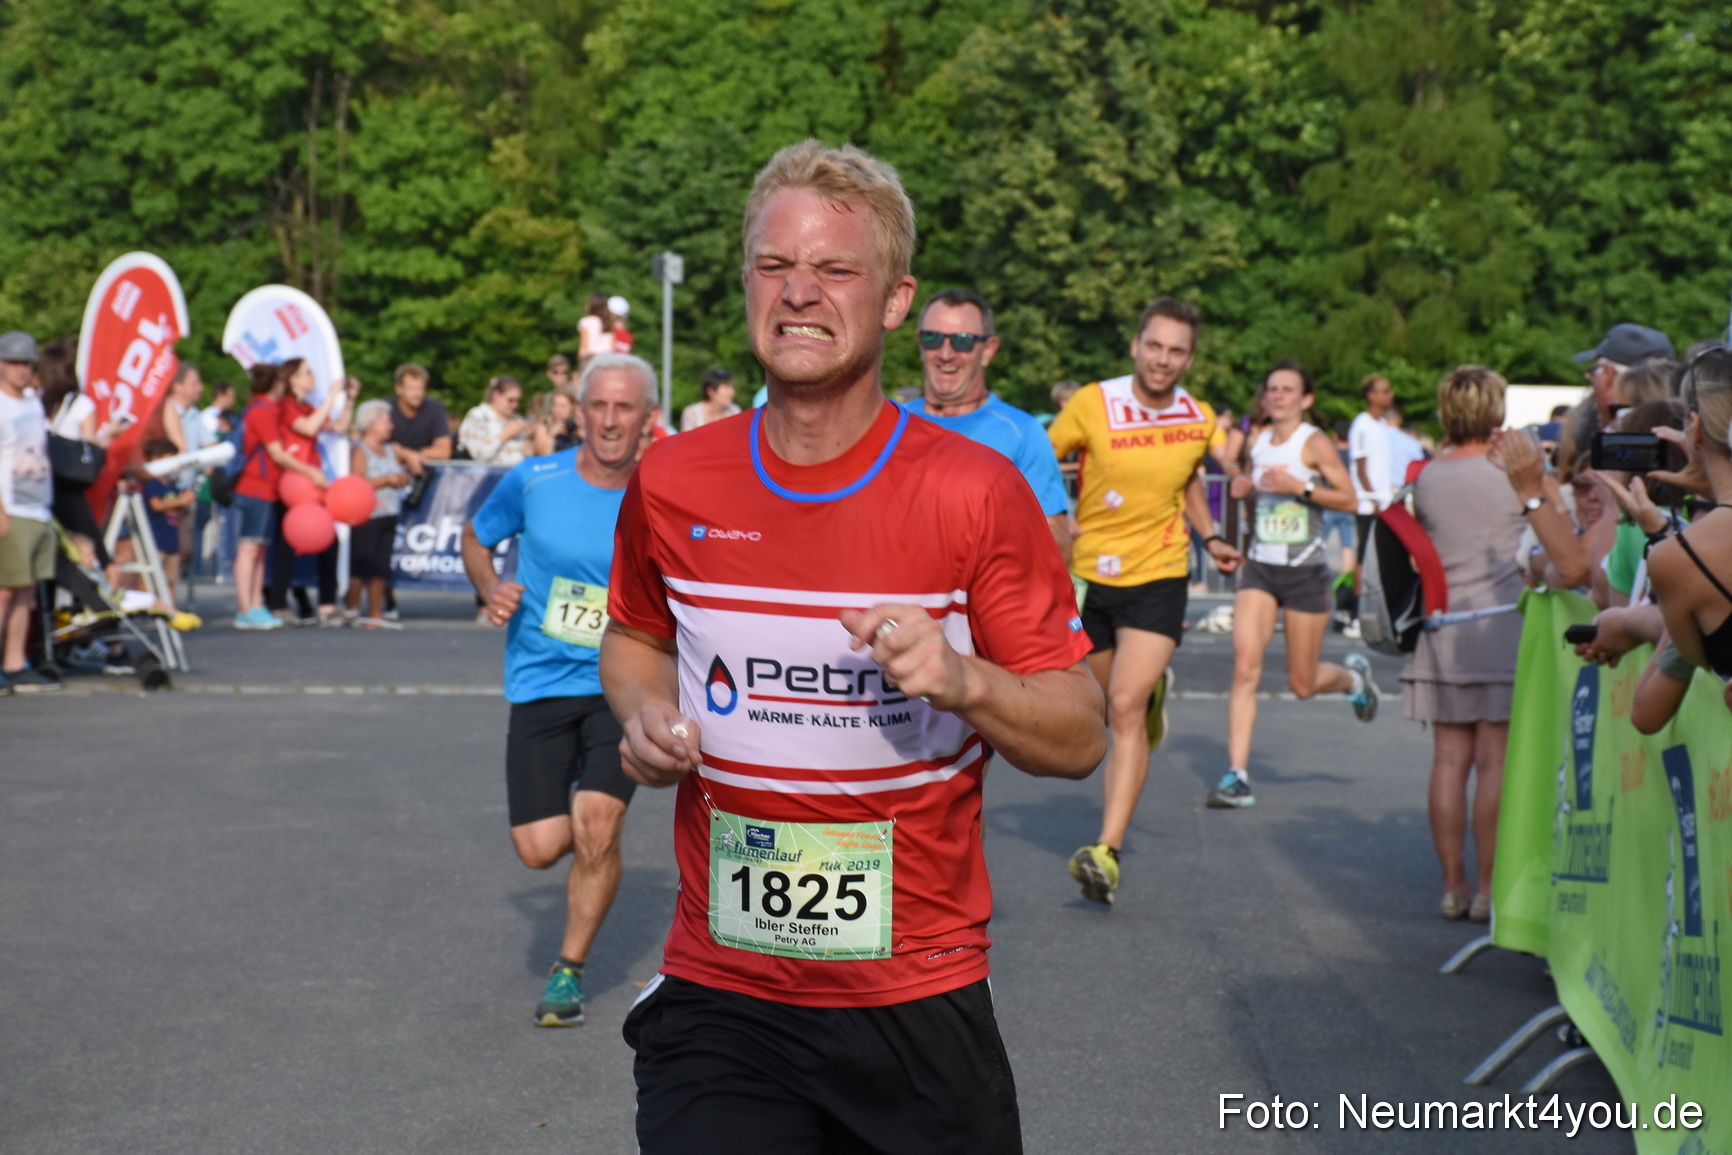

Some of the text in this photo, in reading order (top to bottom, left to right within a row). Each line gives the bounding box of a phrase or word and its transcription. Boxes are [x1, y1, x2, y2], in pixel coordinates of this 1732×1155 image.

[1111, 434, 1154, 450] MAX
[734, 841, 803, 862] firmenlauf
[847, 859, 880, 871] 2019
[732, 866, 867, 921] 1825
[755, 917, 838, 936] Ibler Steffen
[774, 934, 799, 946] Petry
[801, 937, 816, 946] AG
